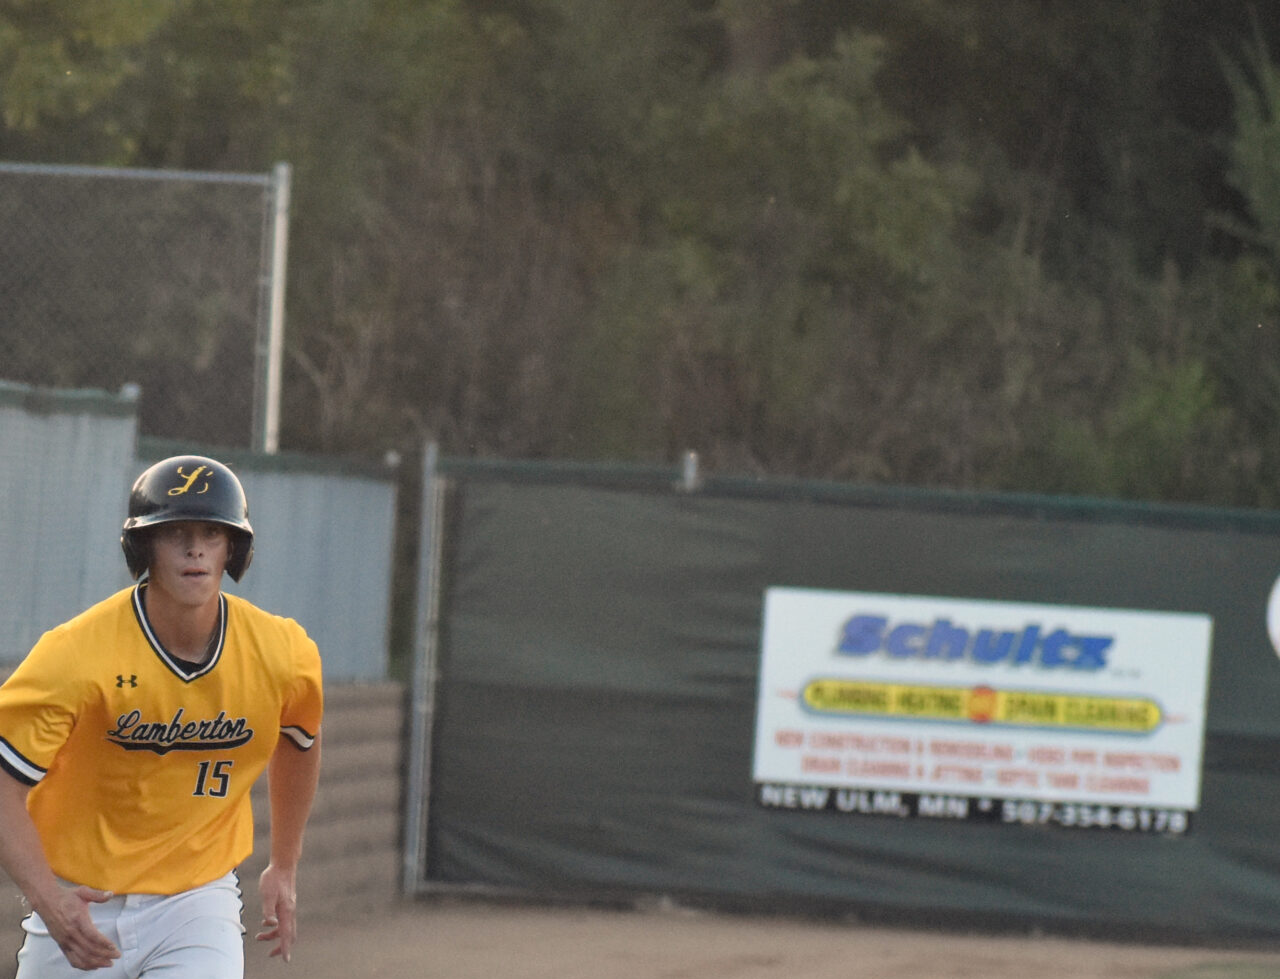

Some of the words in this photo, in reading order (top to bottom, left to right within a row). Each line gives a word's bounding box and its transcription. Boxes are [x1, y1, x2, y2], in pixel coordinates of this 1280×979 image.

[835, 614, 1117, 670] Schultz
[106, 707, 254, 749] Lamberton
[191, 759, 234, 798] 15
[761, 785, 830, 810] NEW
[919, 794, 969, 819] MN
